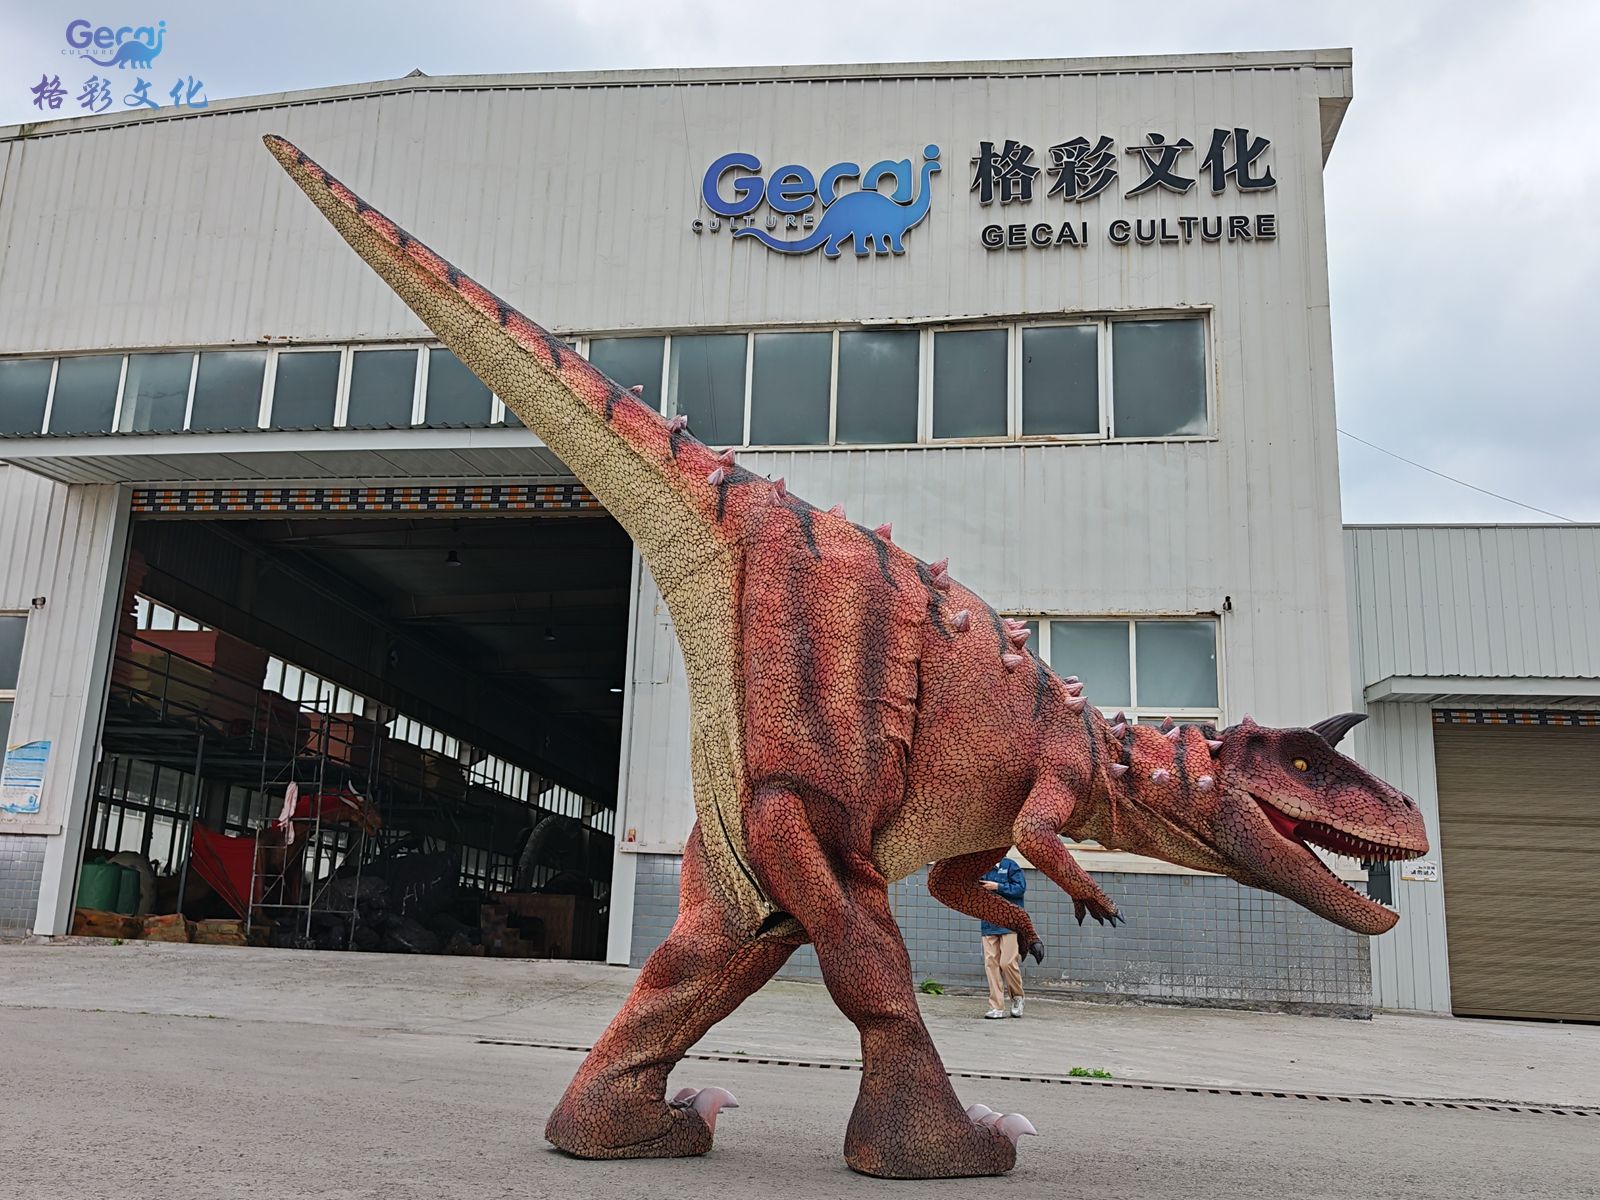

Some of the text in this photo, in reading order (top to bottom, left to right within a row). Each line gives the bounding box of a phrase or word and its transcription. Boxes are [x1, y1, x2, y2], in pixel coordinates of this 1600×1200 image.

[970, 127, 1278, 206] 格彩文化
[692, 213, 815, 234] CULTURE
[980, 213, 1278, 250] GECAI CULTURE
